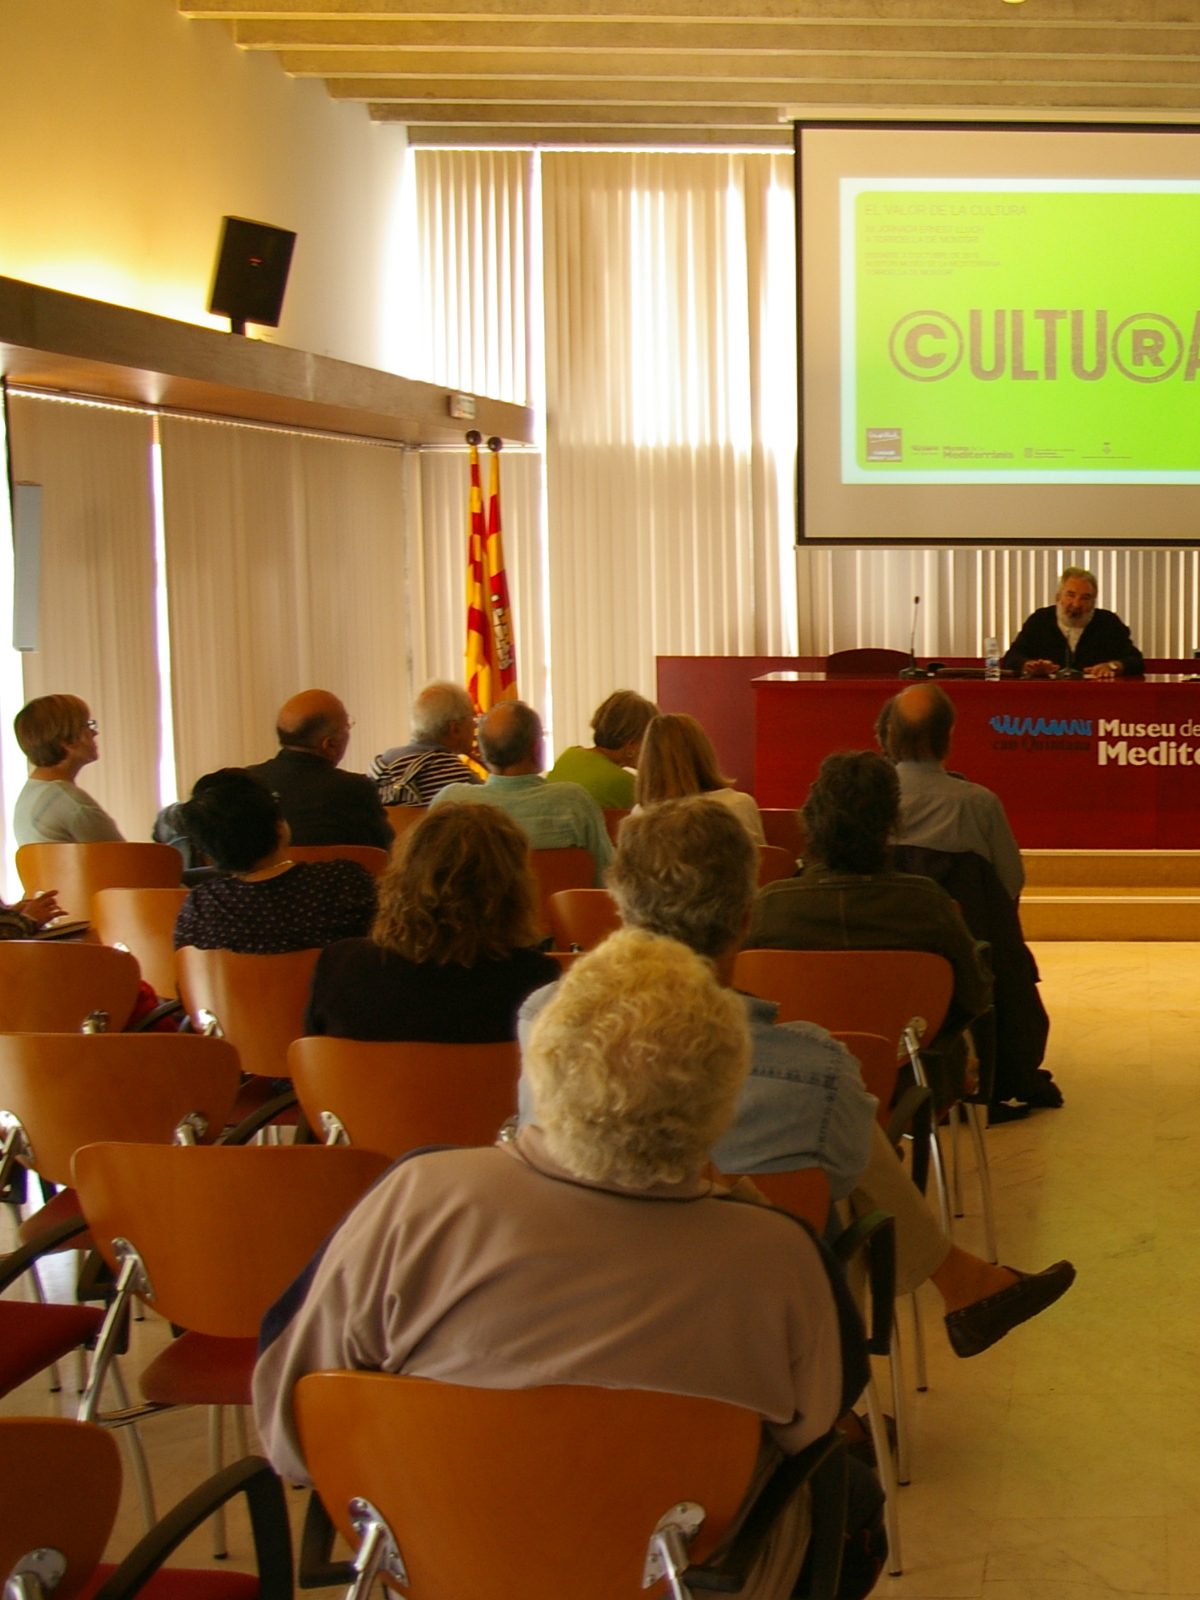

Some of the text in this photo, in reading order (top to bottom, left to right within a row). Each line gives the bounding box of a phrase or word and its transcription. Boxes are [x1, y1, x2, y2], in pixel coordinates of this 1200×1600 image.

[865, 205, 1028, 216] EL VALOR DE LA CULTURA
[1097, 718, 1176, 738] Museu
